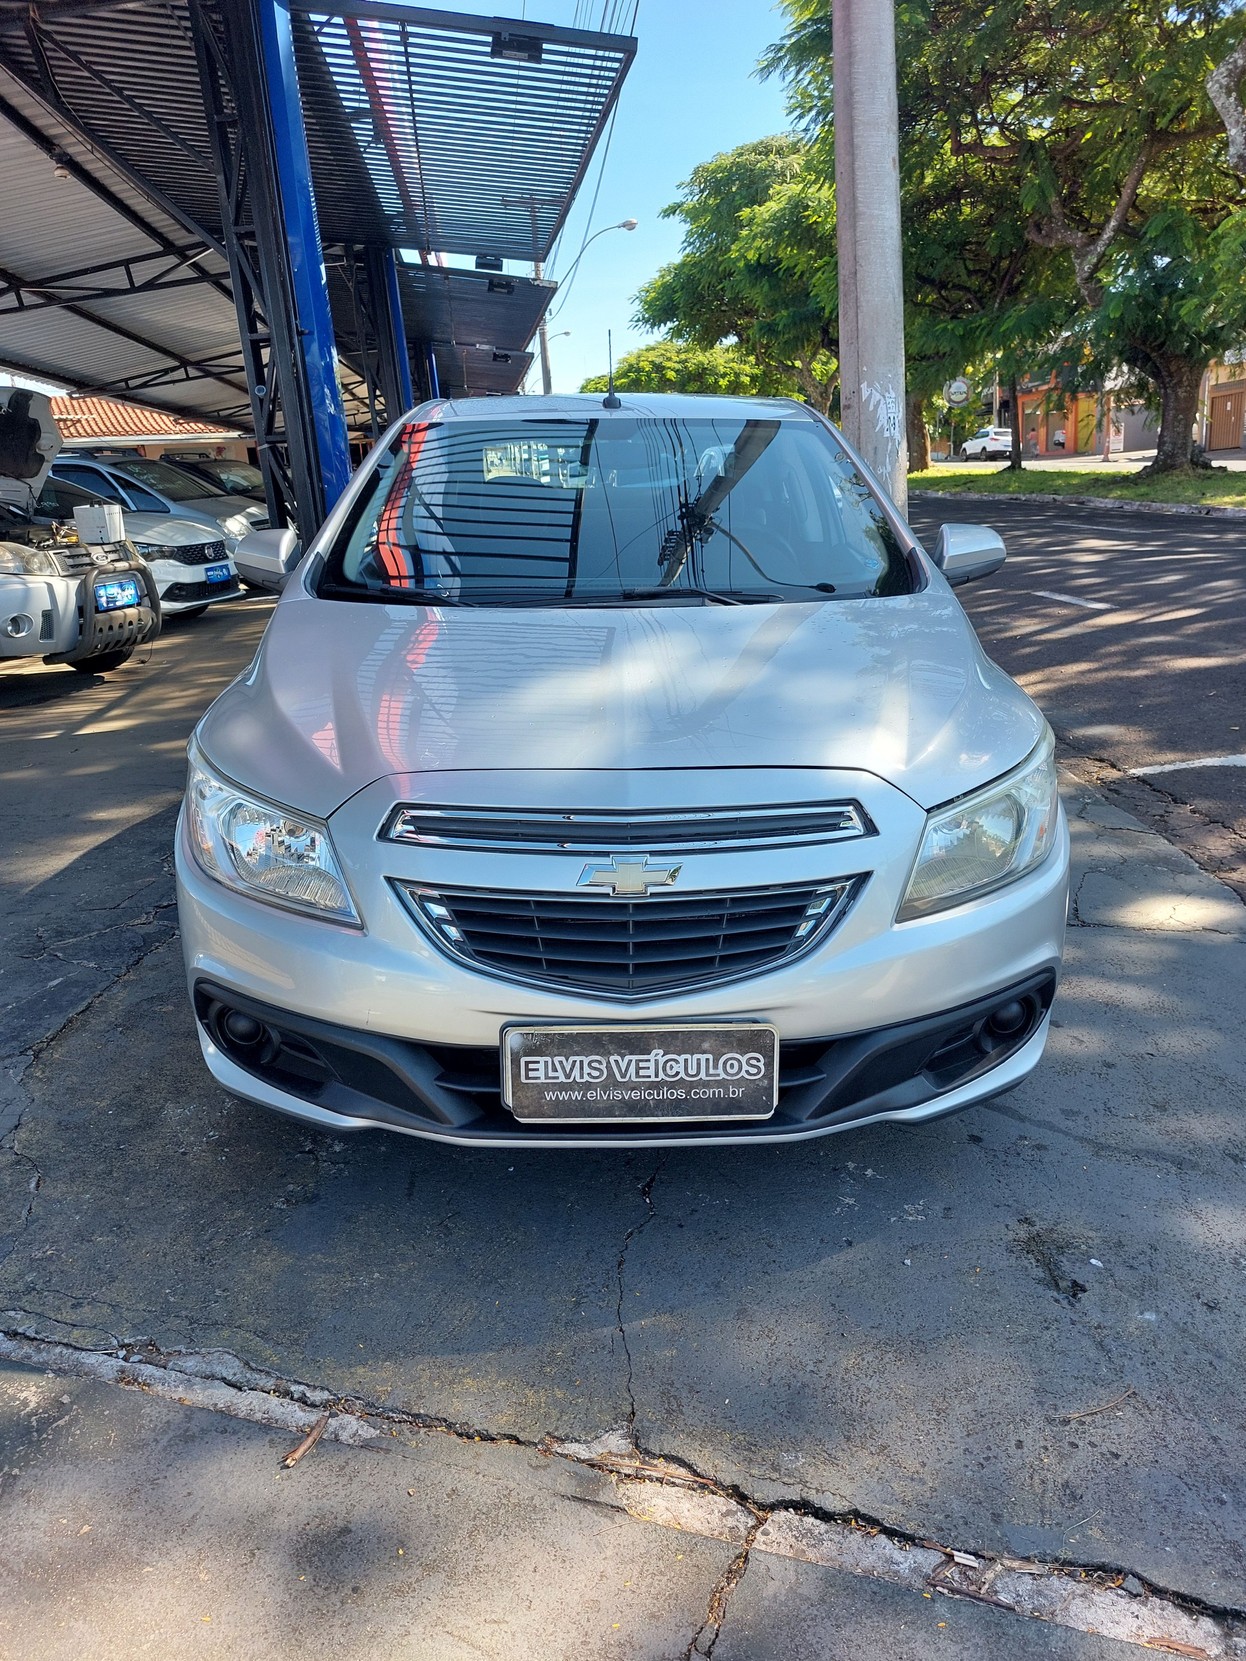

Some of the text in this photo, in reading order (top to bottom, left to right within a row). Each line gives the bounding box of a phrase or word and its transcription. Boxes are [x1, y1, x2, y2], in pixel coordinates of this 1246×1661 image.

[521, 1049, 765, 1083] ELVIS VEÍCULOS
[544, 1086, 745, 1101] www.elvisveiculos.com.br
